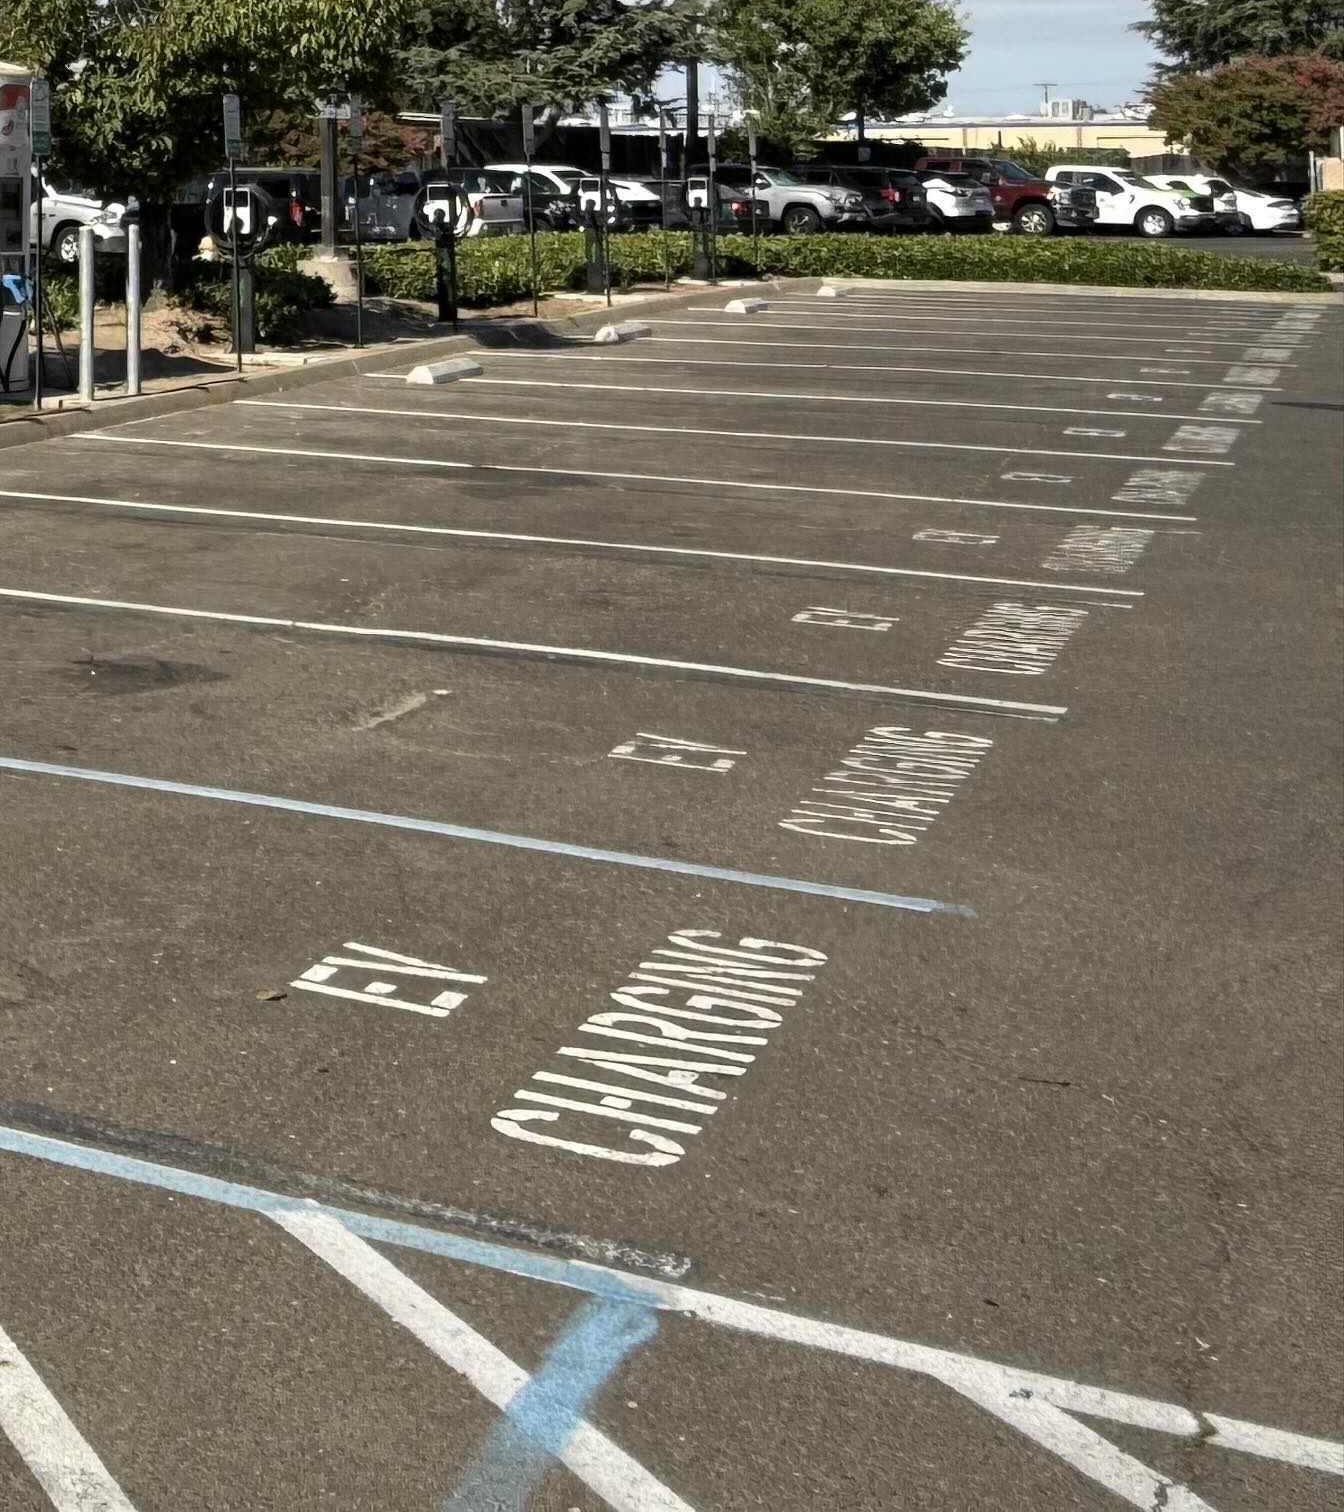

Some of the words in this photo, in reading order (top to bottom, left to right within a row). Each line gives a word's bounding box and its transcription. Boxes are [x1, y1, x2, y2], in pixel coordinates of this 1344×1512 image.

[608, 731, 748, 773] EV
[777, 726, 994, 845] CHARGING
[288, 941, 489, 1018] EV
[491, 928, 828, 1167] CHARGING
